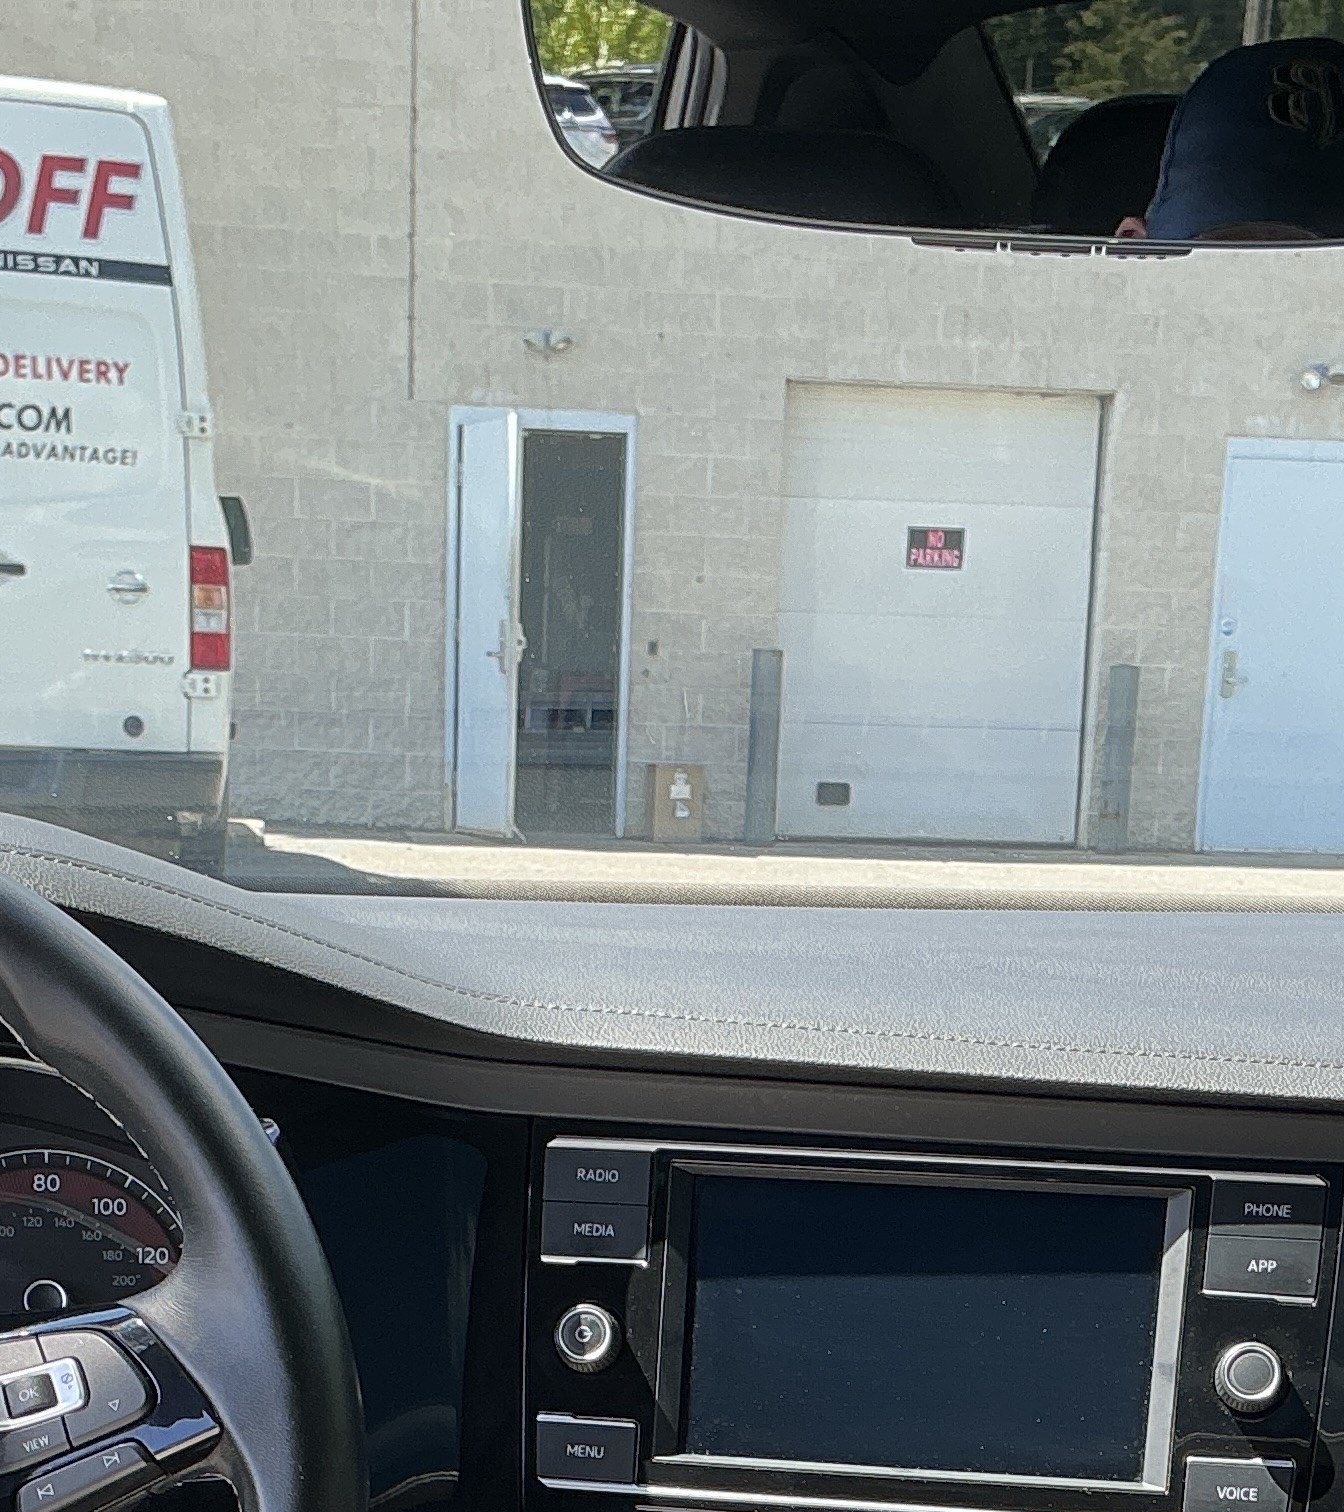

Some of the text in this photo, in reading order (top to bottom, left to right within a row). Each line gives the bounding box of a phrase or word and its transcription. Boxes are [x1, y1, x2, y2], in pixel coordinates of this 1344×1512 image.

[0, 441, 139, 467] ADVANTAGE!
[926, 530, 945, 548] NO
[909, 547, 960, 567] PARKING
[576, 1167, 619, 1182] RADIO
[32, 1173, 61, 1193] 80
[91, 1198, 128, 1216] 100
[1244, 1202, 1293, 1218] PHONE
[22, 1216, 43, 1228] 120
[53, 1217, 75, 1229] 140
[573, 1222, 615, 1237] MEDIA
[81, 1230, 102, 1242] 160
[102, 1250, 123, 1262] 180
[135, 1246, 169, 1265] 120
[1246, 1259, 1277, 1273] APP
[112, 1274, 136, 1286] 200
[18, 1387, 41, 1403] OK
[22, 1434, 50, 1453] VIEW
[566, 1443, 605, 1459] MENU
[1216, 1485, 1259, 1502] VOICE
